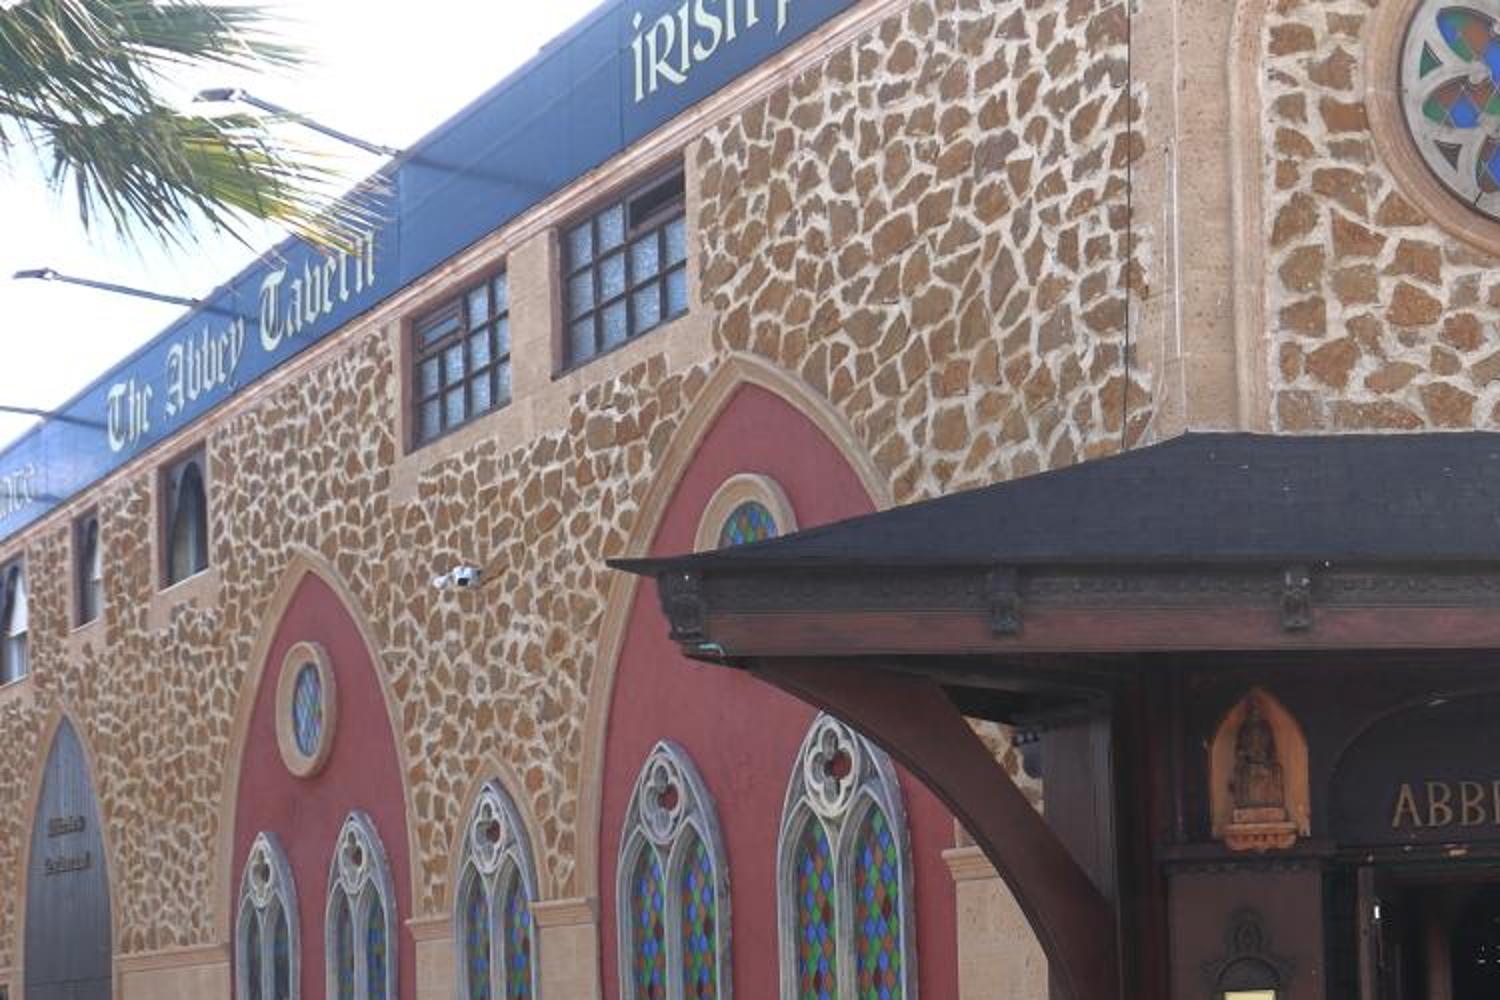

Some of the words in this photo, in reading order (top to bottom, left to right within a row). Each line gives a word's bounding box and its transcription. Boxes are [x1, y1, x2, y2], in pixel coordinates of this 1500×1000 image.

[107, 376, 152, 452] The
[164, 315, 245, 421] Abbey
[259, 228, 375, 351] Tavern
